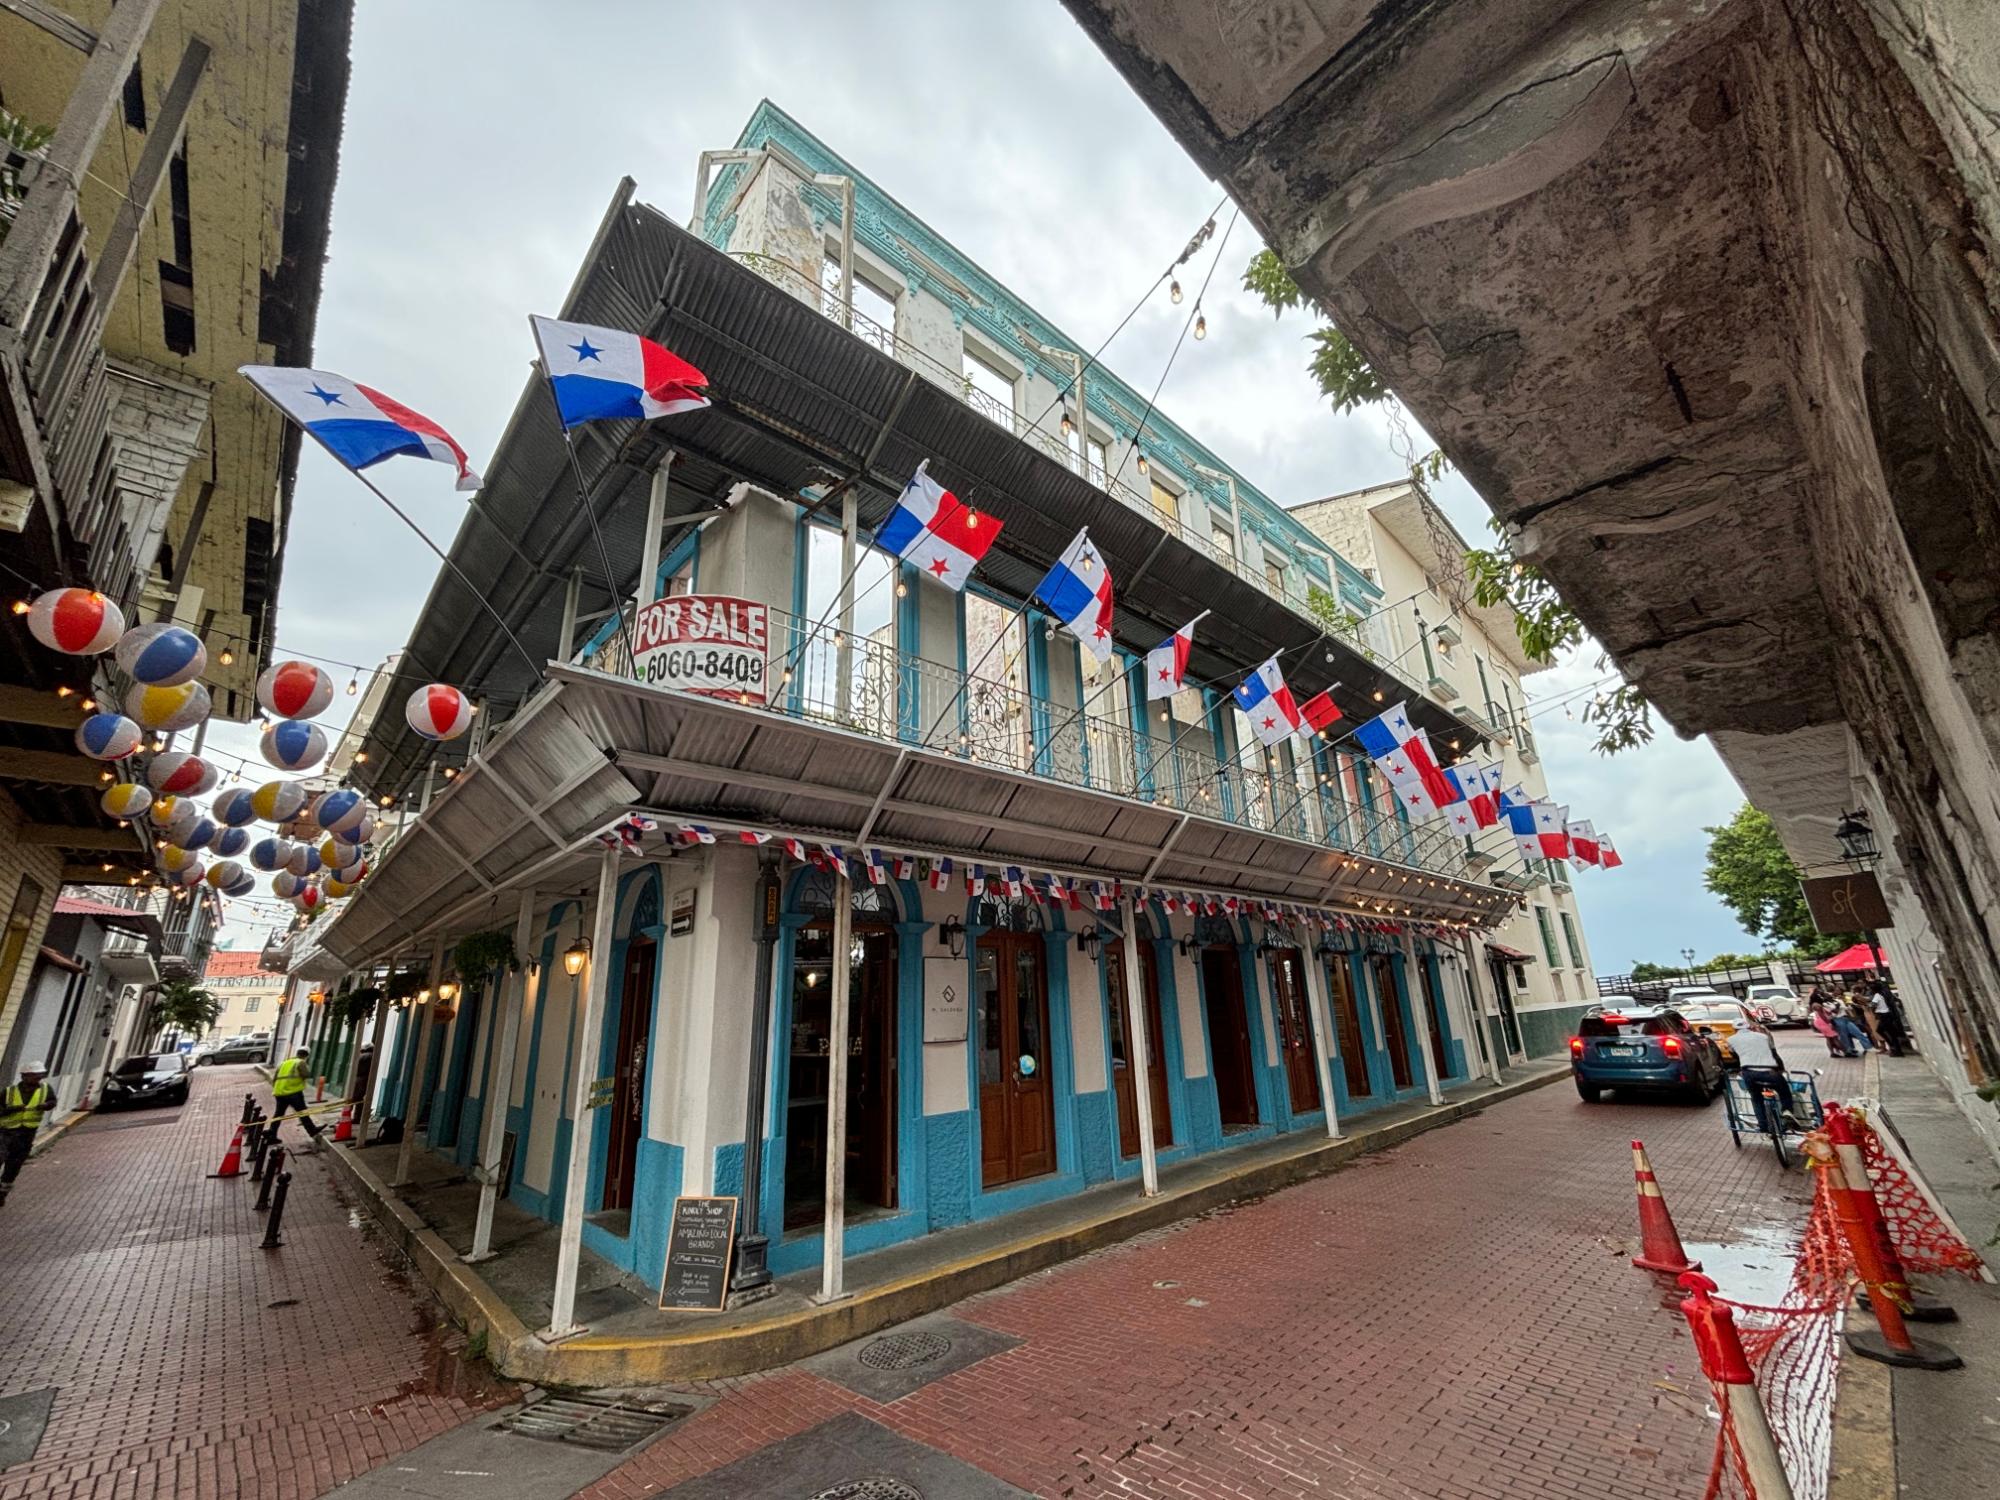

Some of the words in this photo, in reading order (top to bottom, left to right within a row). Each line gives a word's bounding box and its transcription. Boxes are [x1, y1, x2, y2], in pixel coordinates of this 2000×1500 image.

[636, 602, 681, 650] FOR
[687, 600, 766, 646] SALE
[647, 650, 763, 684] 6060-8409
[688, 1240, 715, 1249] BRANDS
[710, 1229, 728, 1239] LOCAL
